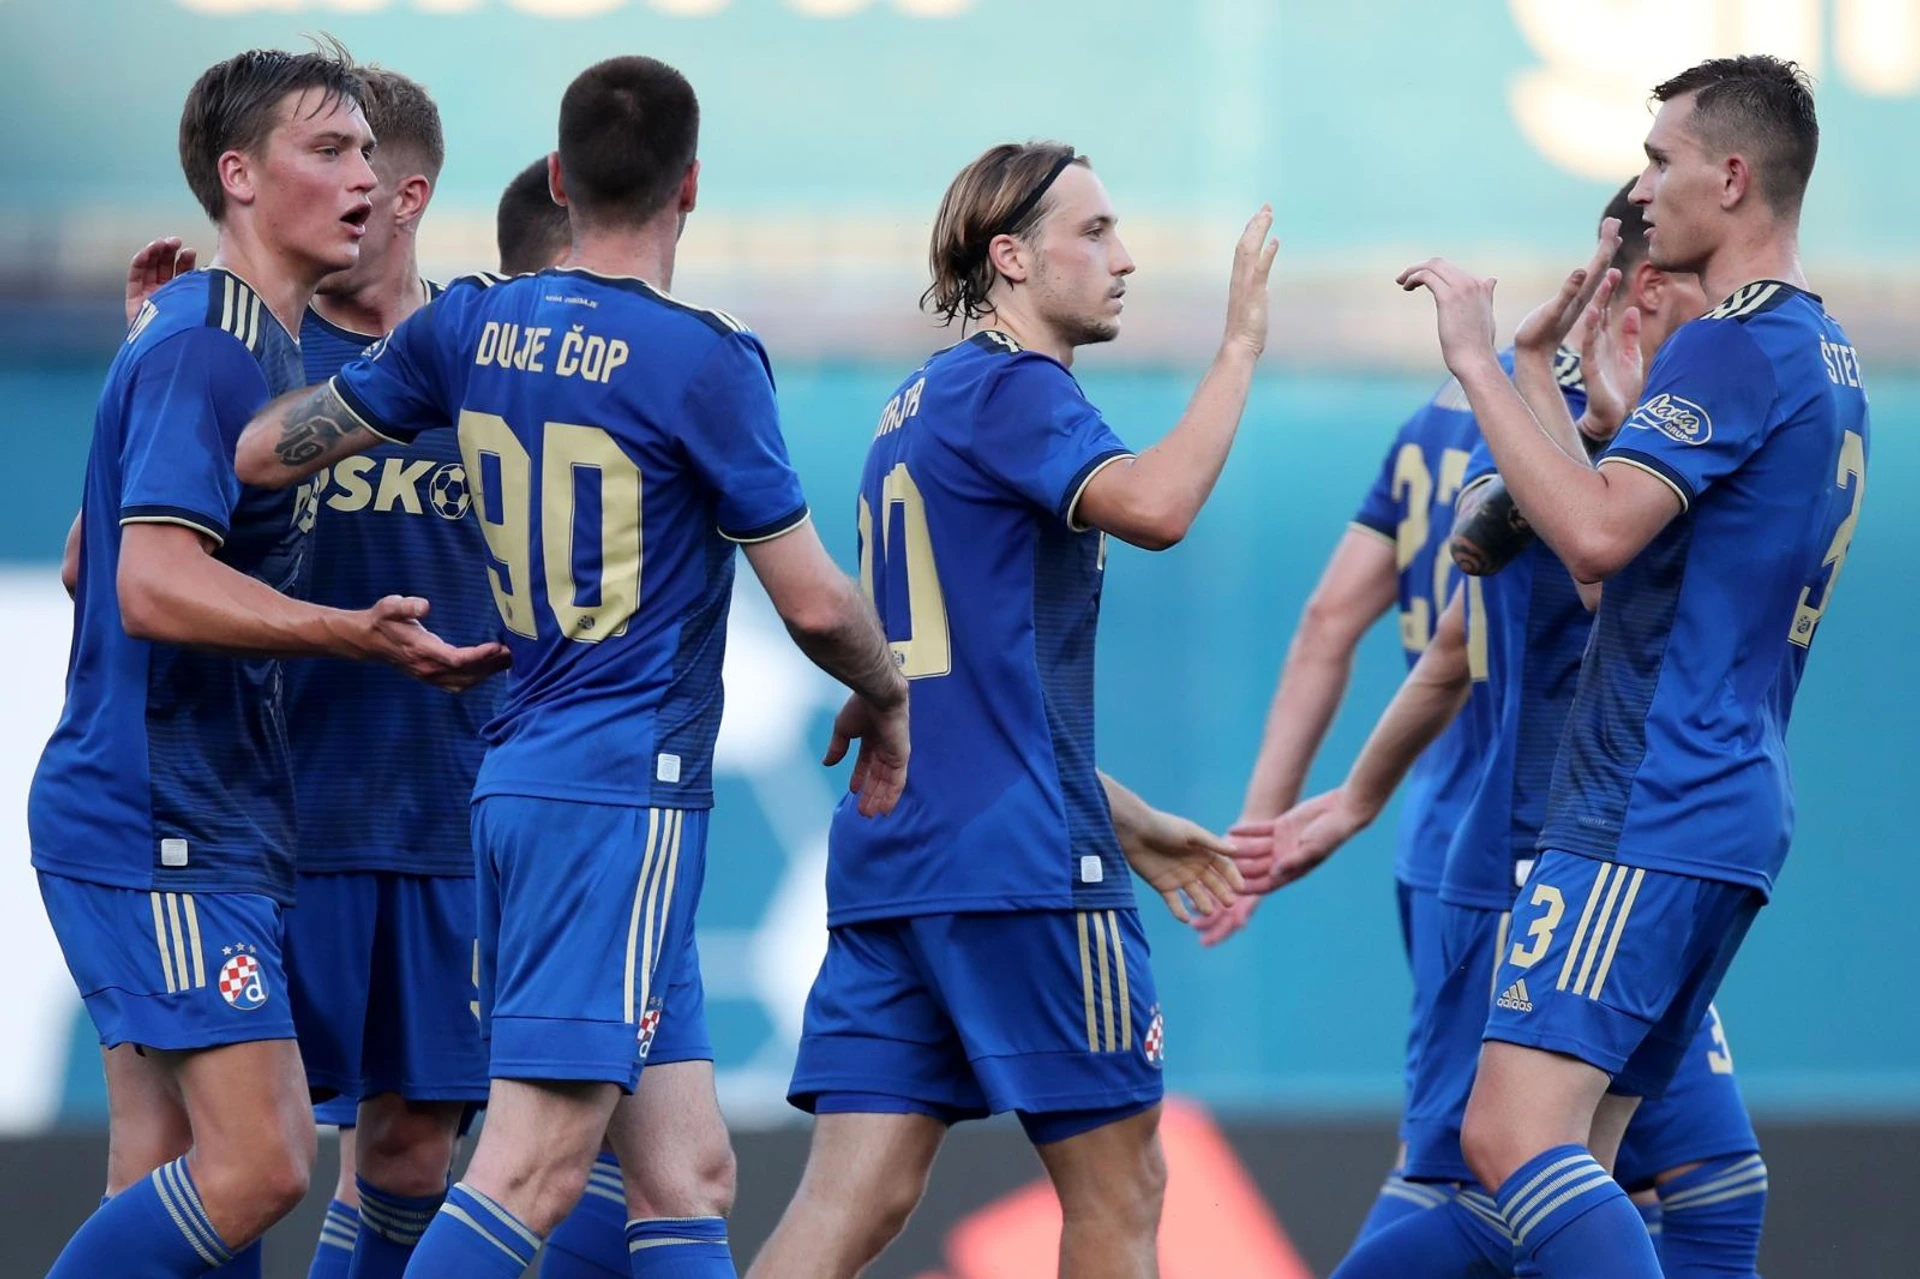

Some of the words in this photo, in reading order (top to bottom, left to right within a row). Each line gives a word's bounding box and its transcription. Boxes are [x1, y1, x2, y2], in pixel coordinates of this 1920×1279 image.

[476, 321, 552, 372] DUJE
[556, 324, 629, 384] ČOP
[457, 408, 643, 643] 90
[1787, 429, 1865, 649] 3
[1508, 884, 1565, 969] 3
[1496, 997, 1534, 1013] adidas
